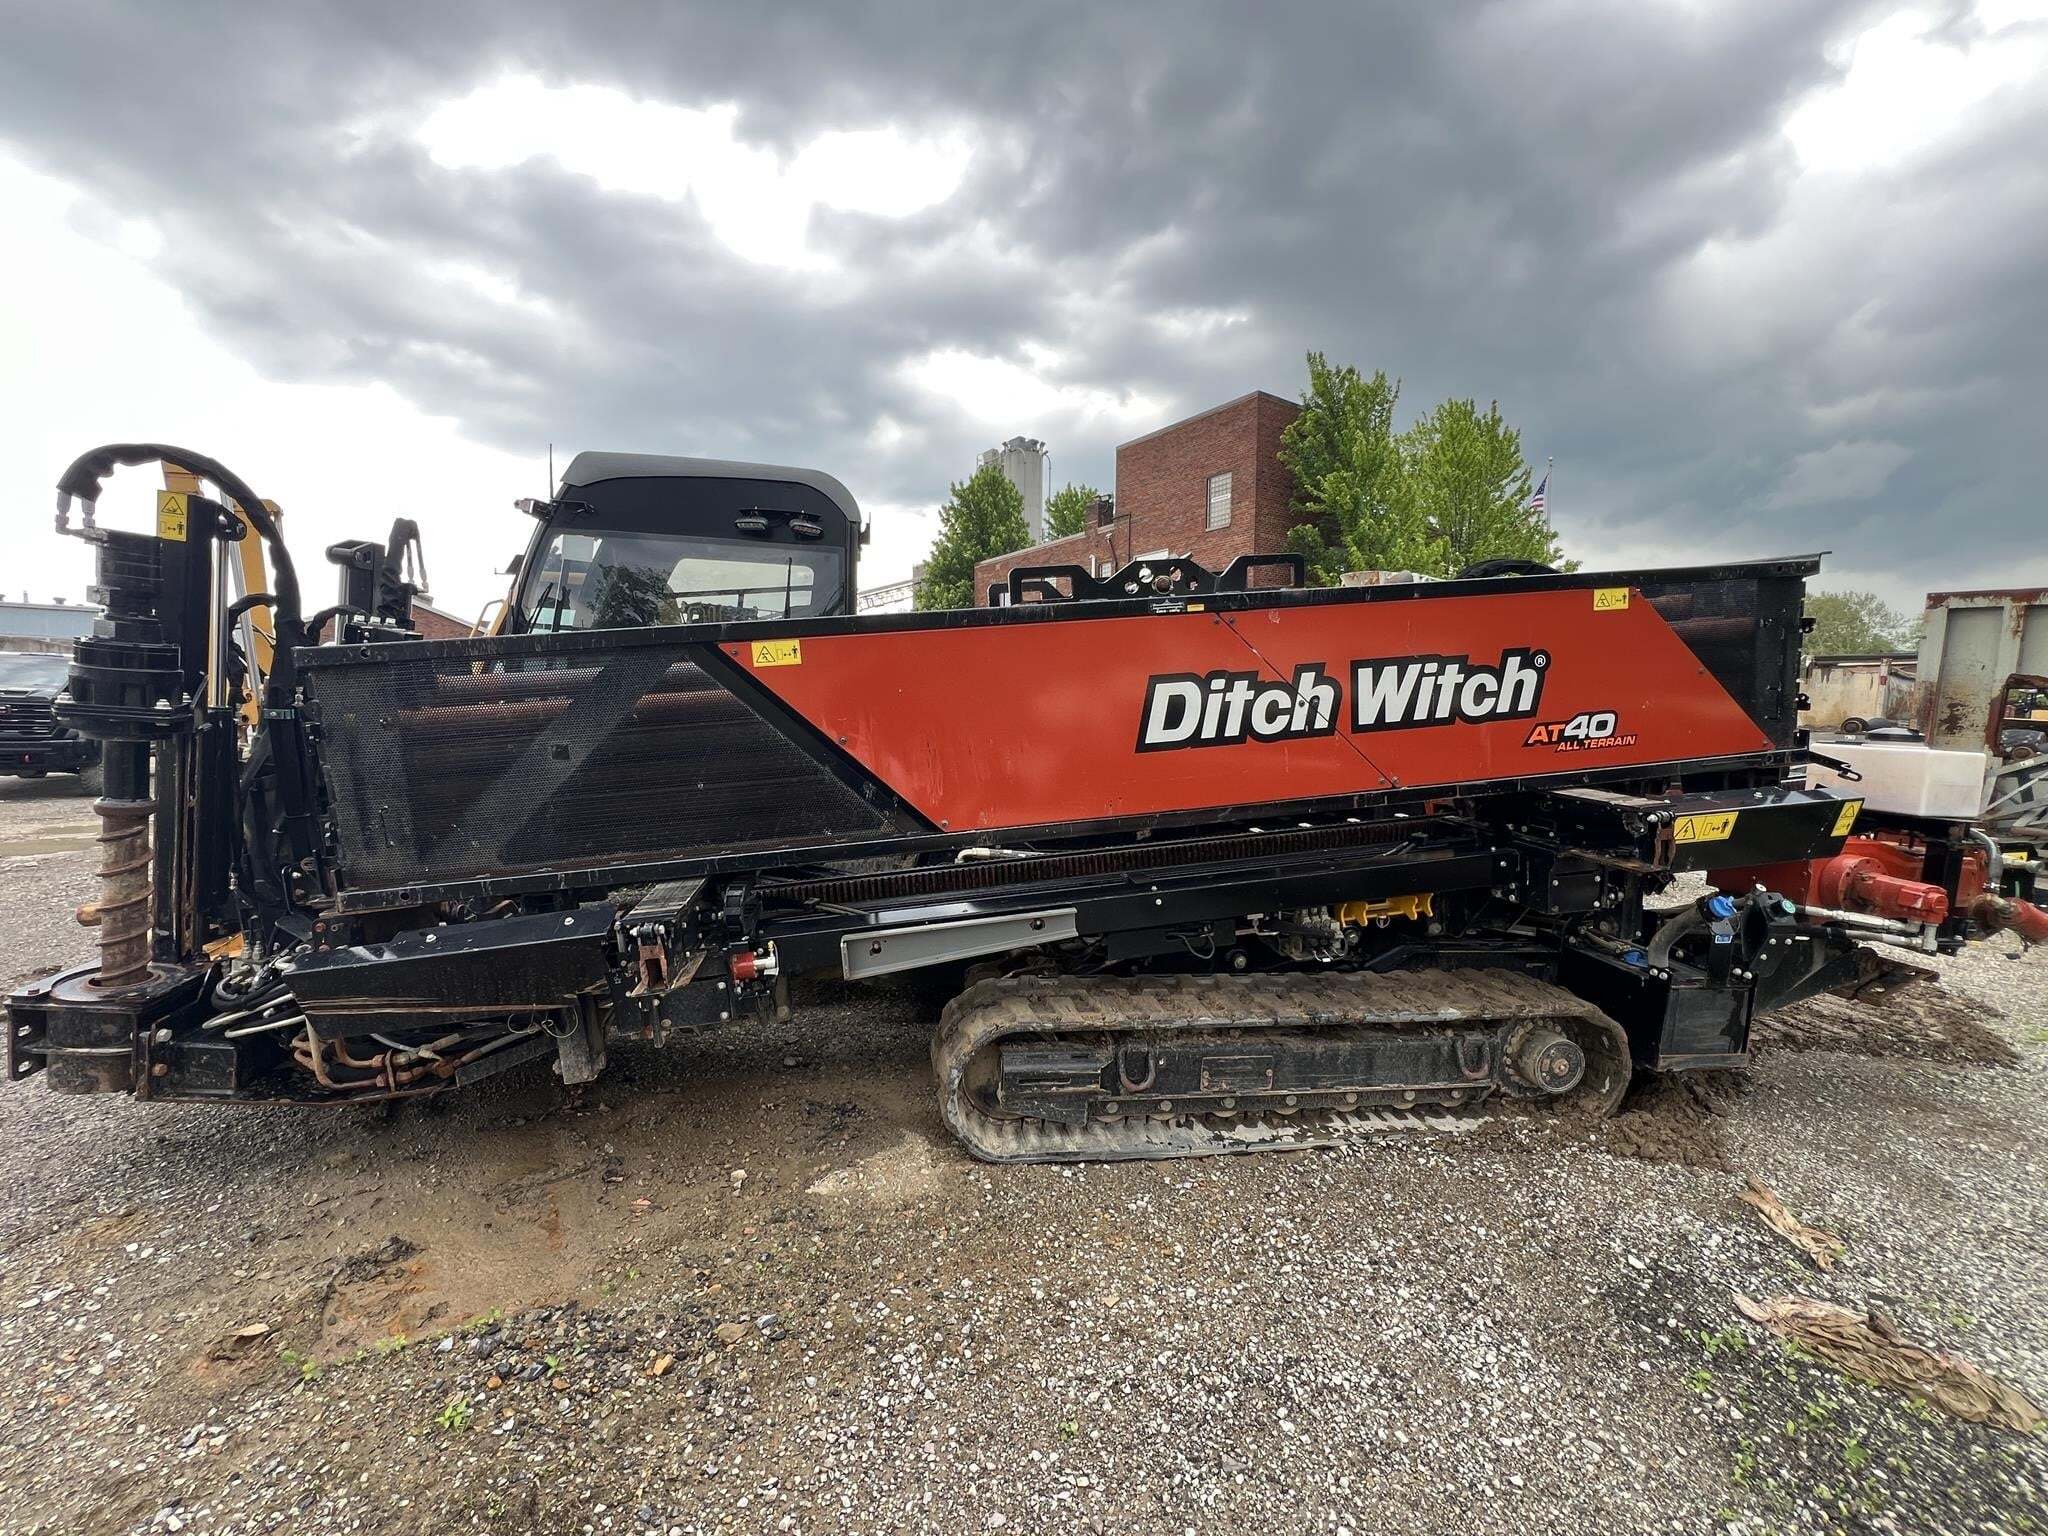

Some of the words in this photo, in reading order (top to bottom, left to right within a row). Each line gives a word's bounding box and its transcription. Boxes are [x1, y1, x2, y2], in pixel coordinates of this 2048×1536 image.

[1145, 671, 1335, 744] Ditch
[1528, 713, 1616, 743] AT40
[1557, 741, 1580, 752] ALL
[1584, 736, 1636, 749] TERRAIN
